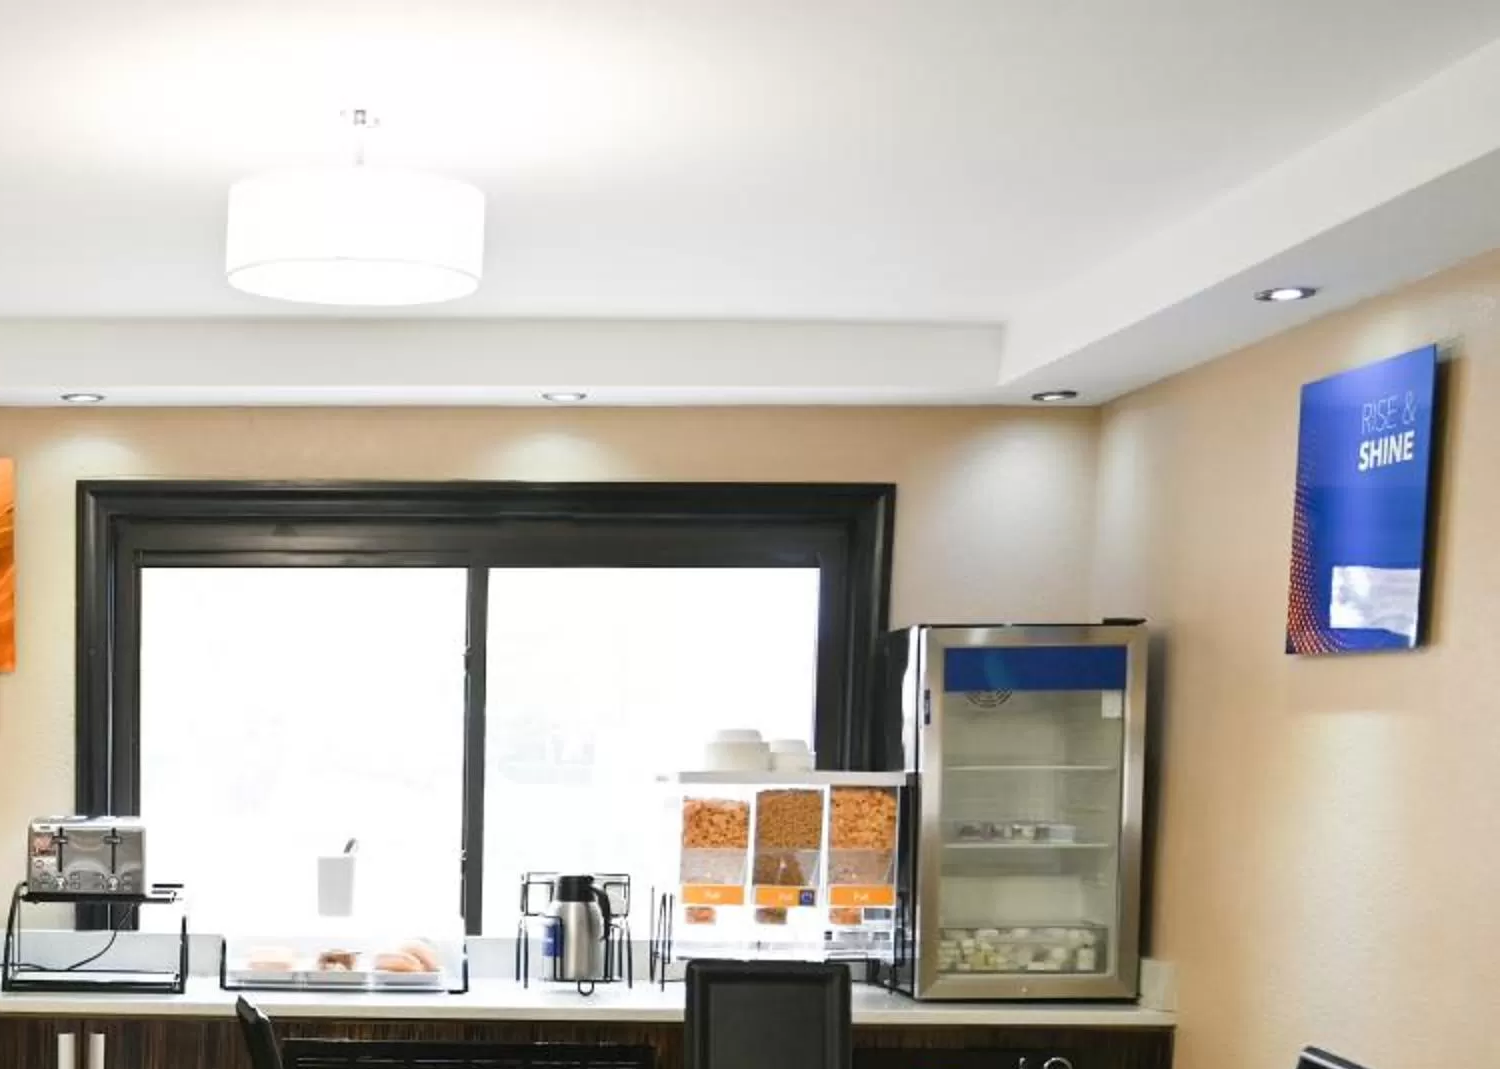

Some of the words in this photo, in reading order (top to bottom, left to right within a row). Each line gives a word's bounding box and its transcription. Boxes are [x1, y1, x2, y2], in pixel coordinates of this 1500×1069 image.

[1361, 394, 1398, 434] RISE
[1402, 390, 1416, 425] &
[1358, 430, 1415, 472] SHINE
